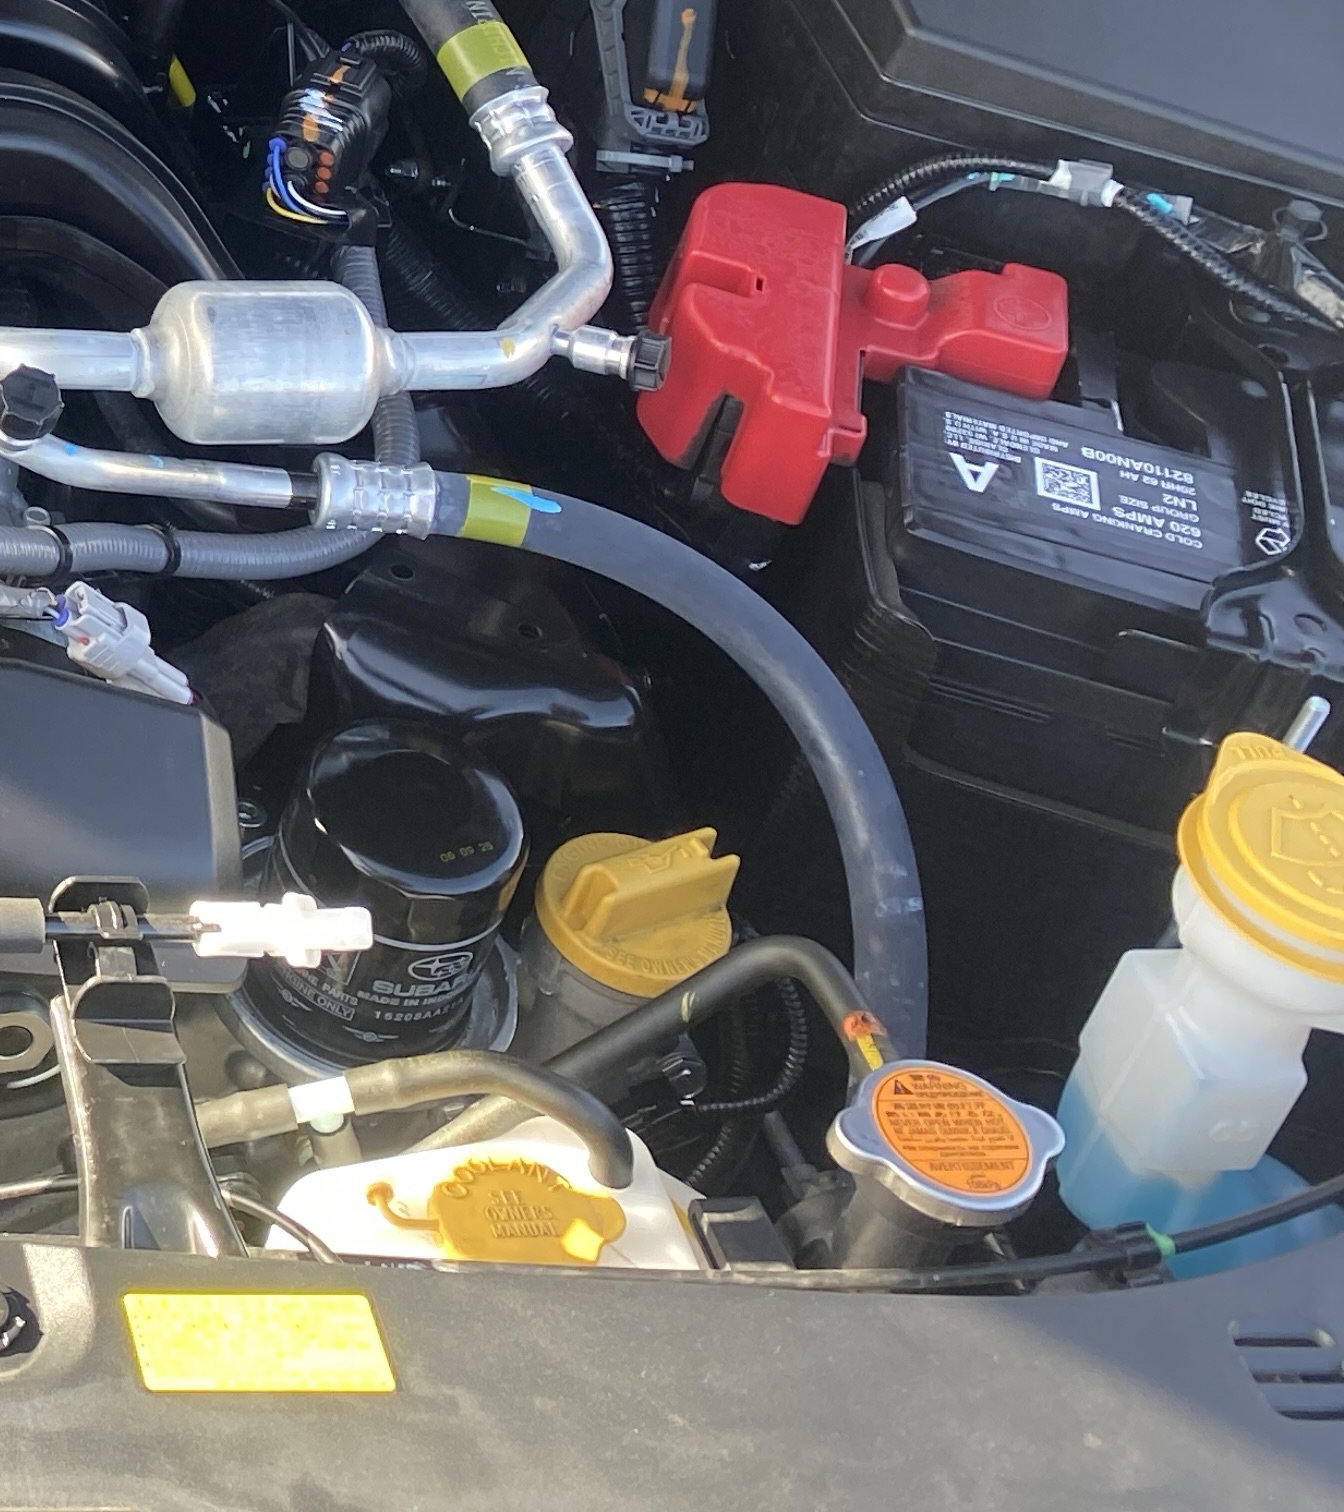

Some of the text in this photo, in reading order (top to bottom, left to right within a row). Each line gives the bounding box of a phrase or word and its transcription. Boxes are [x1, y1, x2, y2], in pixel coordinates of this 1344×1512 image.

[1080, 446, 1195, 485] 82110AN00B
[1119, 469, 1140, 482] AH
[1118, 494, 1200, 523] GROUP SIZE
[1161, 493, 1198, 512] LN2
[1051, 502, 1203, 549] COLD CRANKING AMPS
[1111, 506, 1202, 538] 620 AMPS
[1229, 744, 1287, 761] PULL
[605, 946, 637, 970] SEE
[321, 983, 359, 1006] PARTS
[356, 990, 419, 1007] MADE IN
[316, 995, 353, 1018] ONLY
[440, 1155, 573, 1199] COOLANT
[487, 1189, 523, 1206] SEE
[490, 1221, 562, 1239] MANUAL
